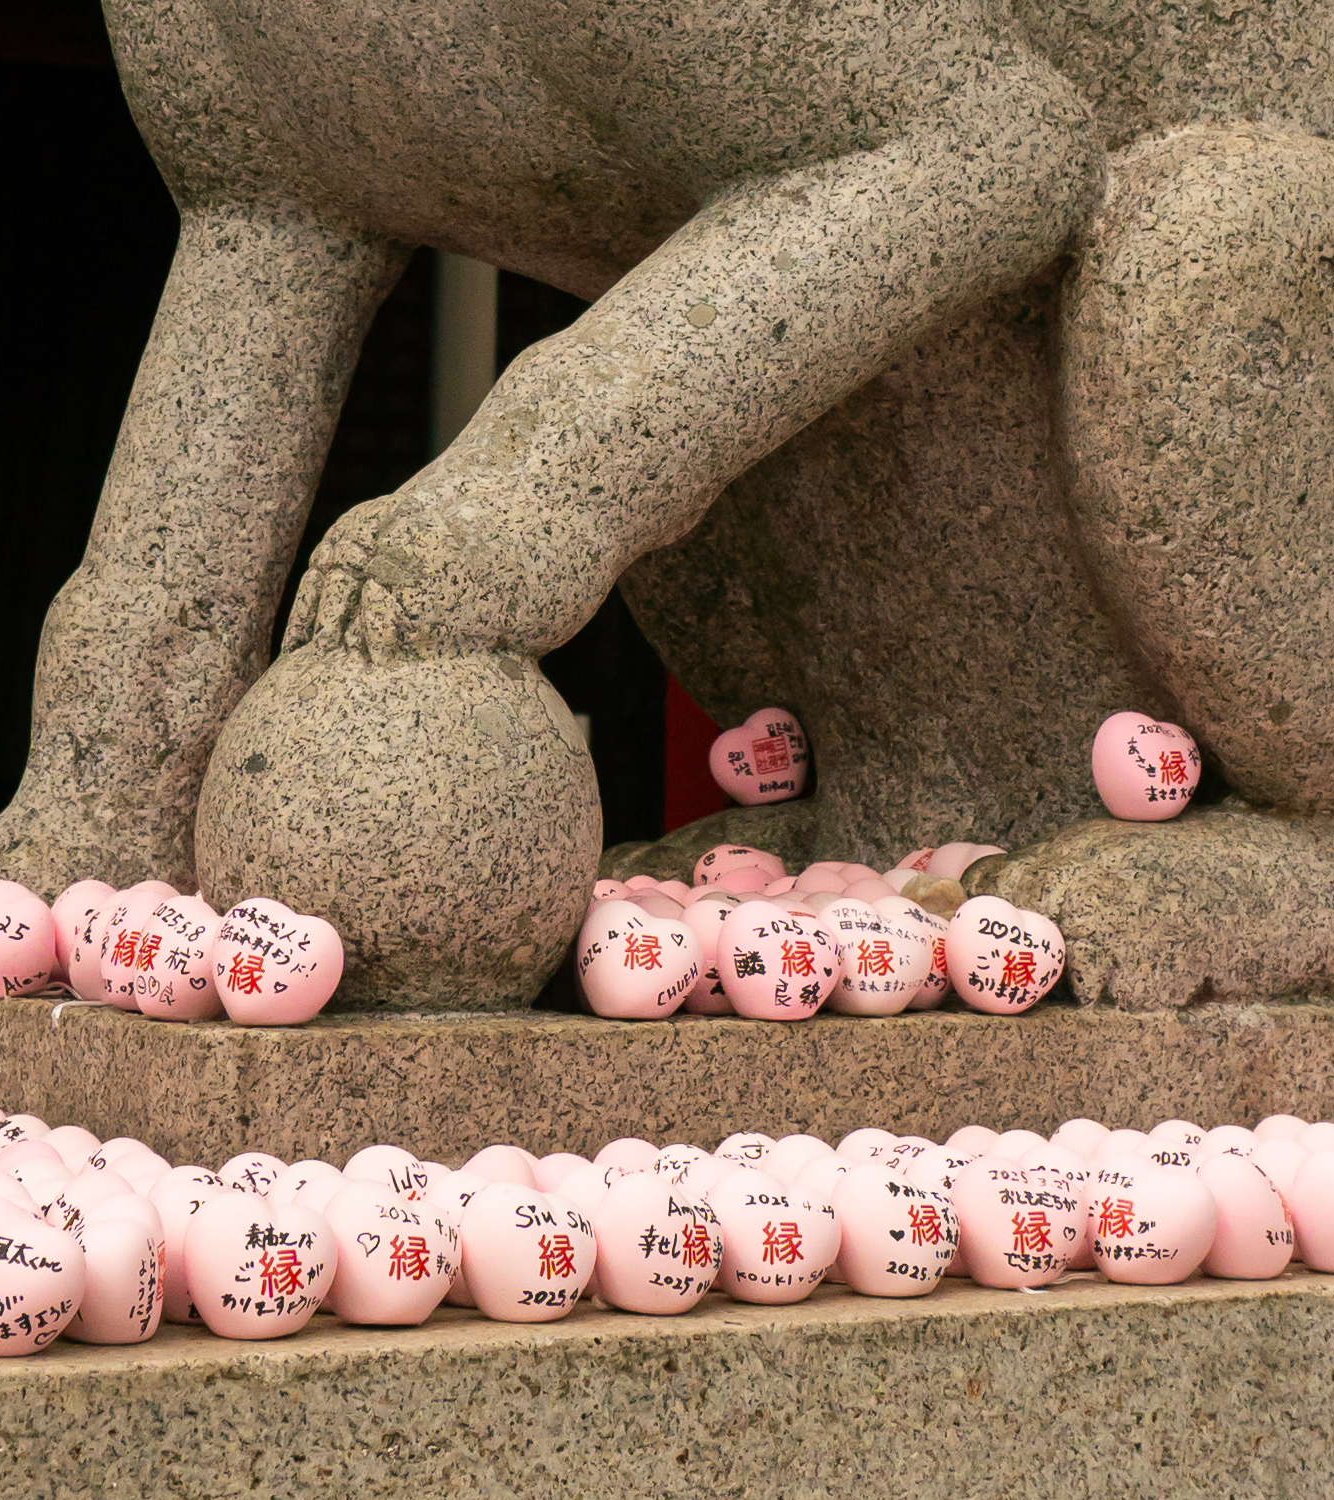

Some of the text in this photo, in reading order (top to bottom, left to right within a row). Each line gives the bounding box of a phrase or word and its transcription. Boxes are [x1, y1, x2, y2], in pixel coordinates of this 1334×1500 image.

[1159, 750, 1189, 786] 縁
[226, 951, 266, 995] 縁
[622, 932, 663, 972] 縁
[780, 939, 817, 978] 縁
[856, 939, 895, 978] 縁
[1002, 950, 1037, 988] 縁
[908, 1203, 945, 1247] 縁
[1011, 1210, 1054, 1255] 縁
[1097, 1196, 1136, 1239] 縁
[388, 1233, 431, 1281] 縁
[537, 1233, 577, 1281] 縁
[681, 1222, 713, 1269] 縁
[761, 1220, 805, 1266] 縁
[258, 1249, 305, 1298] 縁
